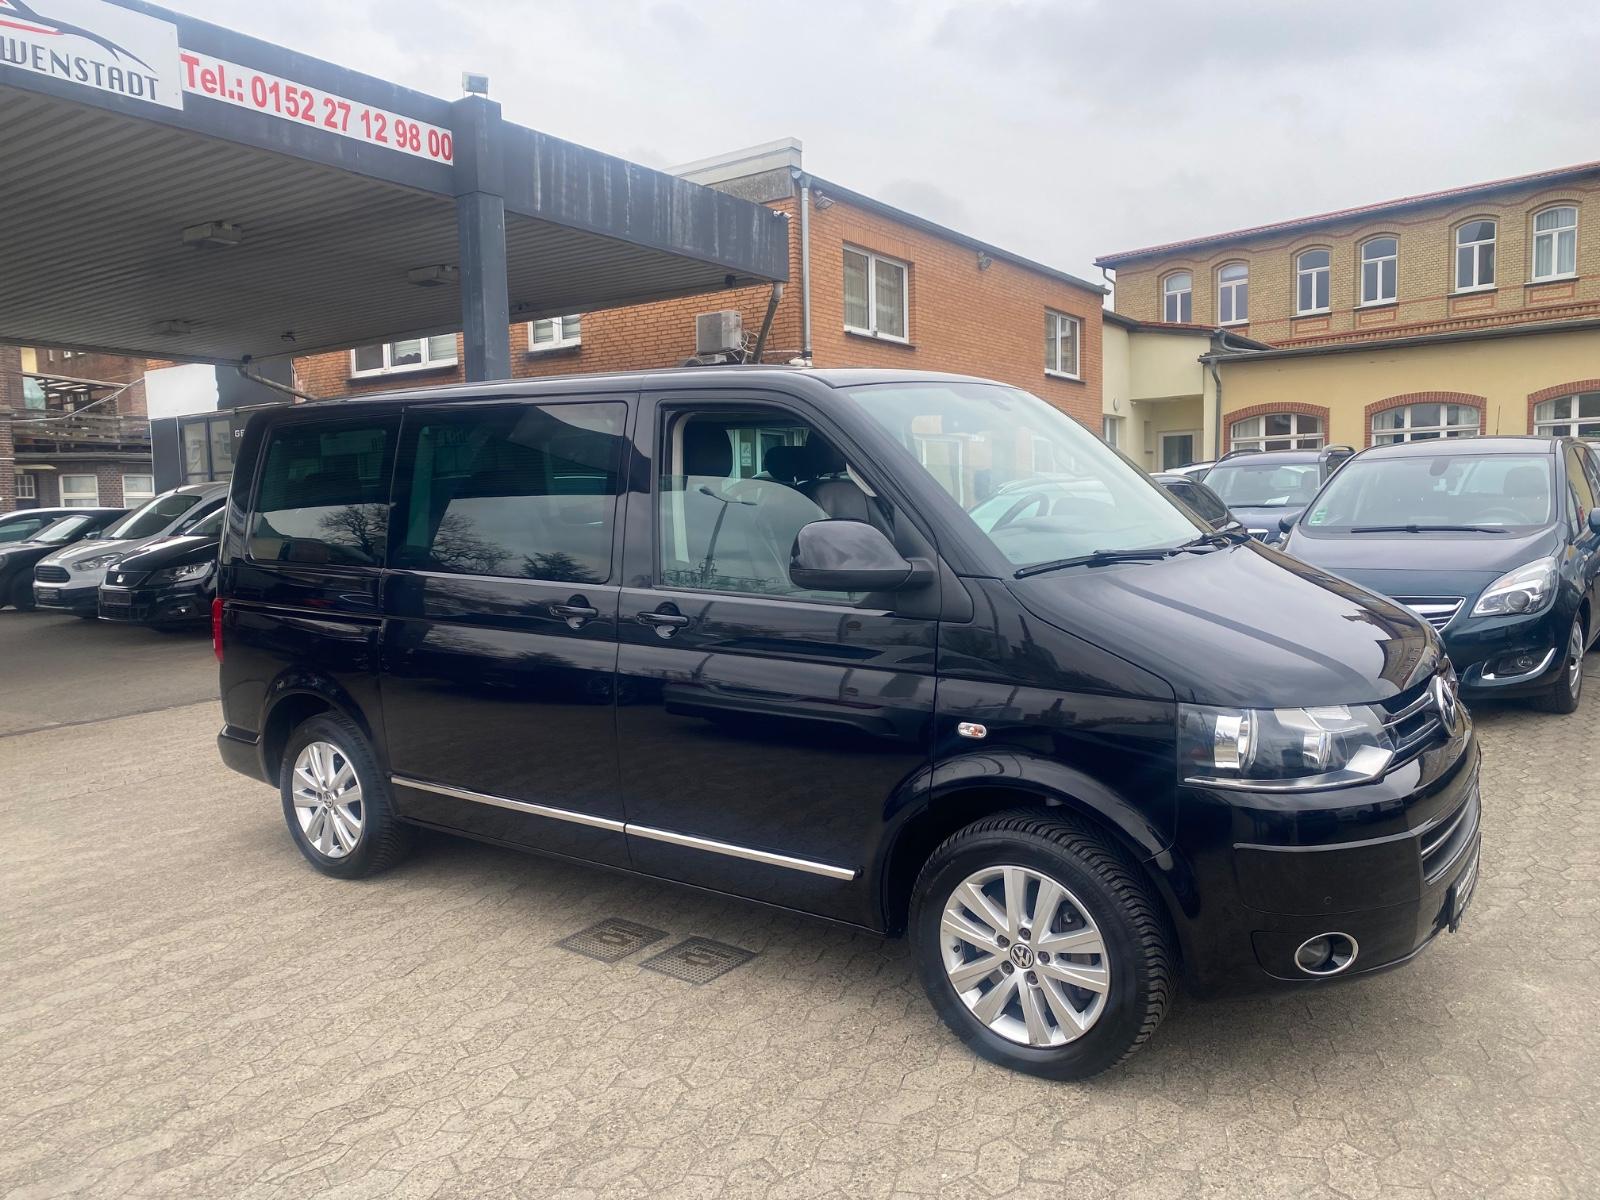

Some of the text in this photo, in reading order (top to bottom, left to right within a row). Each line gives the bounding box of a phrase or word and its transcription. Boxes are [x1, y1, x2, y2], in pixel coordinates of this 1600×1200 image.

[180, 53, 452, 161] Tel.: 0152 27 12 98 00
